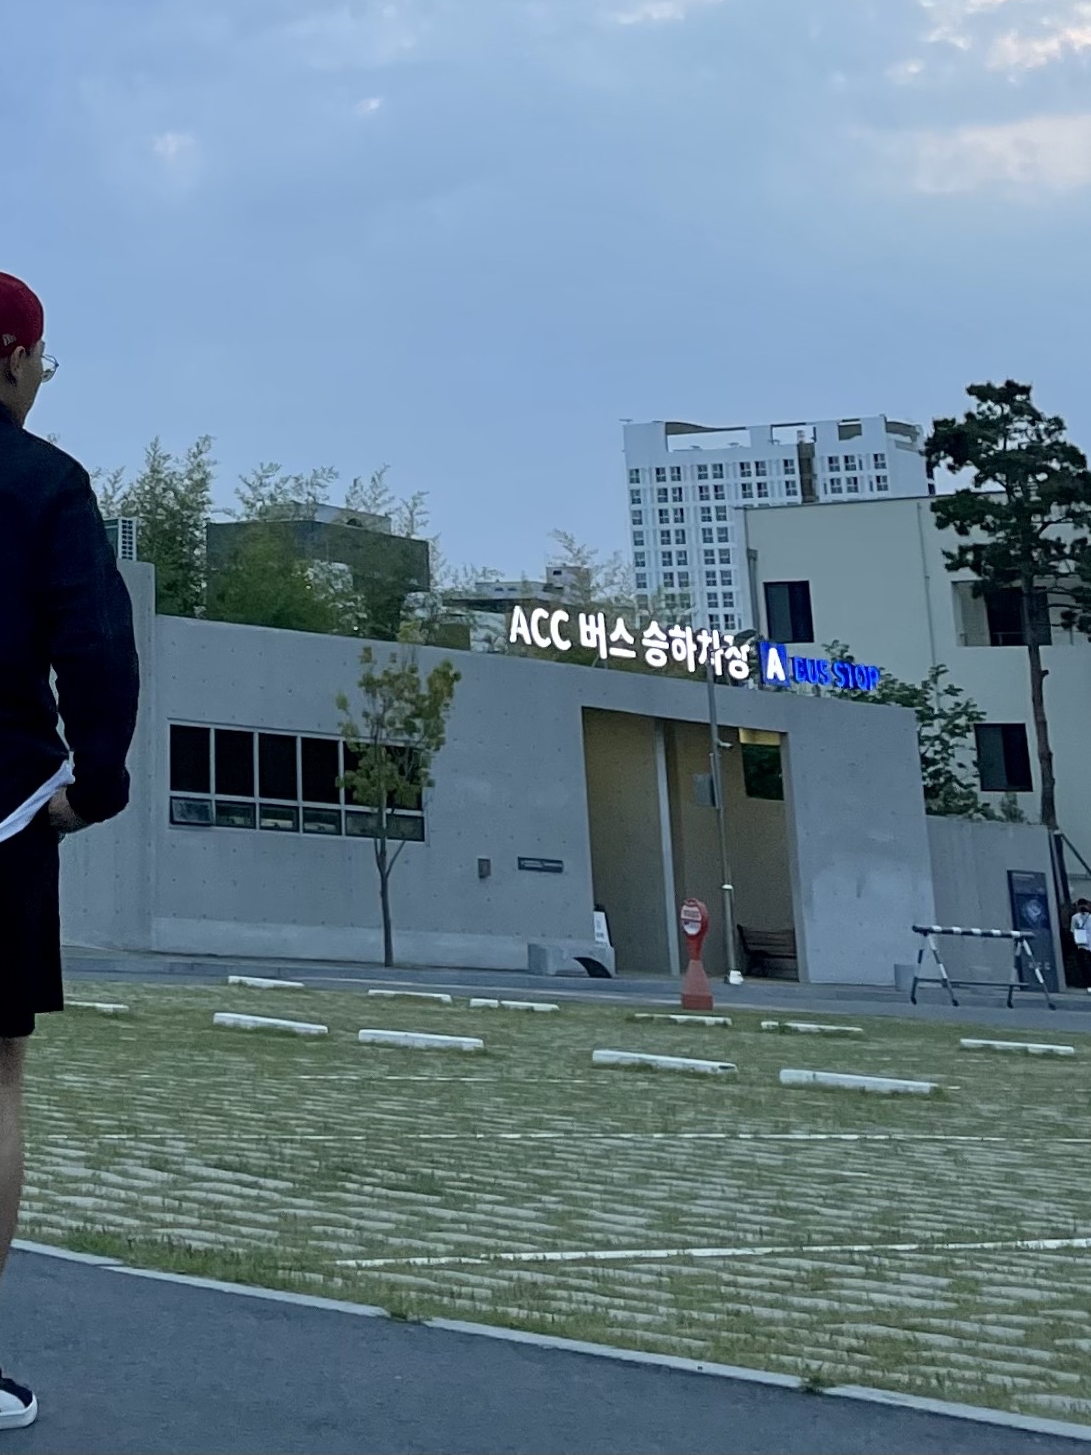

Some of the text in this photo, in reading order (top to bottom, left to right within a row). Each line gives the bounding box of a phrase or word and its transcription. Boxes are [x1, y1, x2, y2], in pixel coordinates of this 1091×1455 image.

[509, 605, 572, 651] ACC
[766, 647, 880, 691] A BUS STOP
